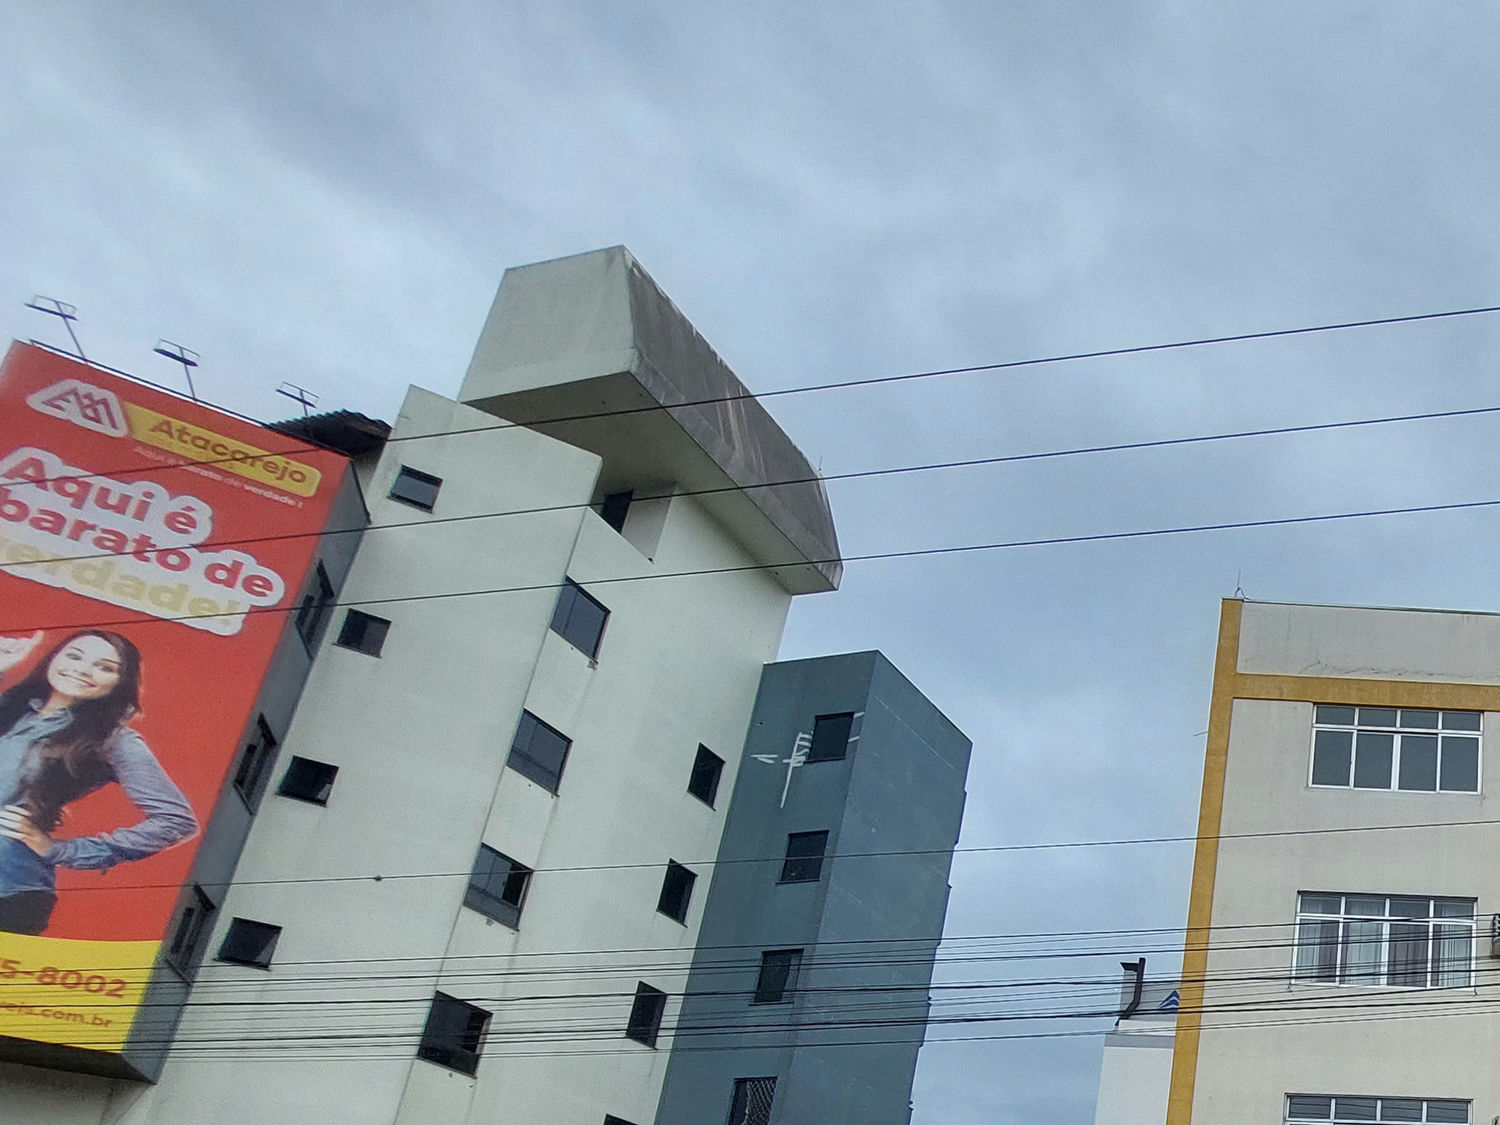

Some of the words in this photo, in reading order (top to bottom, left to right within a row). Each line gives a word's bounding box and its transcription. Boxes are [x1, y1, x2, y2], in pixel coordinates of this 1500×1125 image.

[150, 419, 307, 484] Atacarejo
[3, 456, 152, 522] Aqui
[163, 505, 197, 534] é
[0, 484, 192, 571] barato
[204, 559, 274, 597] de
[0, 538, 240, 626] erdade!
